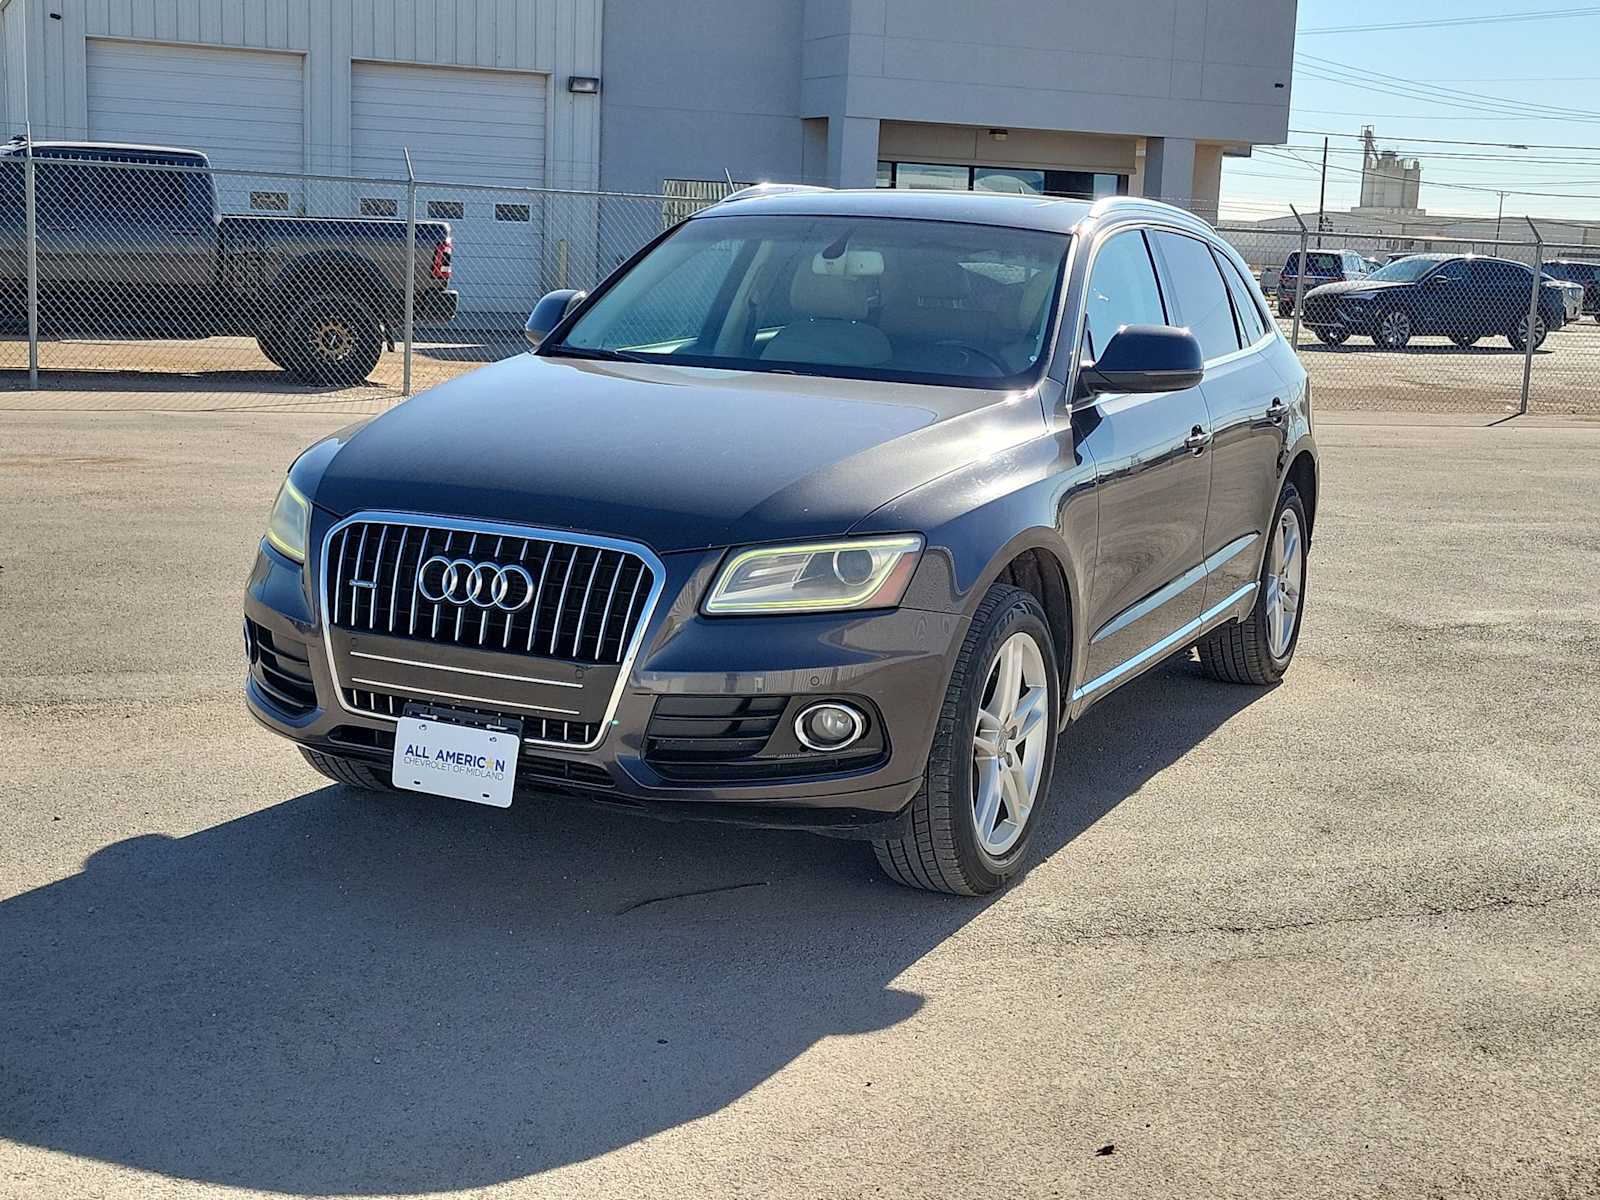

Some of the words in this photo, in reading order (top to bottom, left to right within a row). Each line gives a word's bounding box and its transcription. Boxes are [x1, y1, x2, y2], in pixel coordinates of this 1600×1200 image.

[404, 757, 452, 771] CHEVROLET
[452, 765, 465, 774] OF
[466, 767, 504, 781] MIDLAND
[405, 744, 429, 759] ALL
[435, 749, 505, 772] AMERICN
